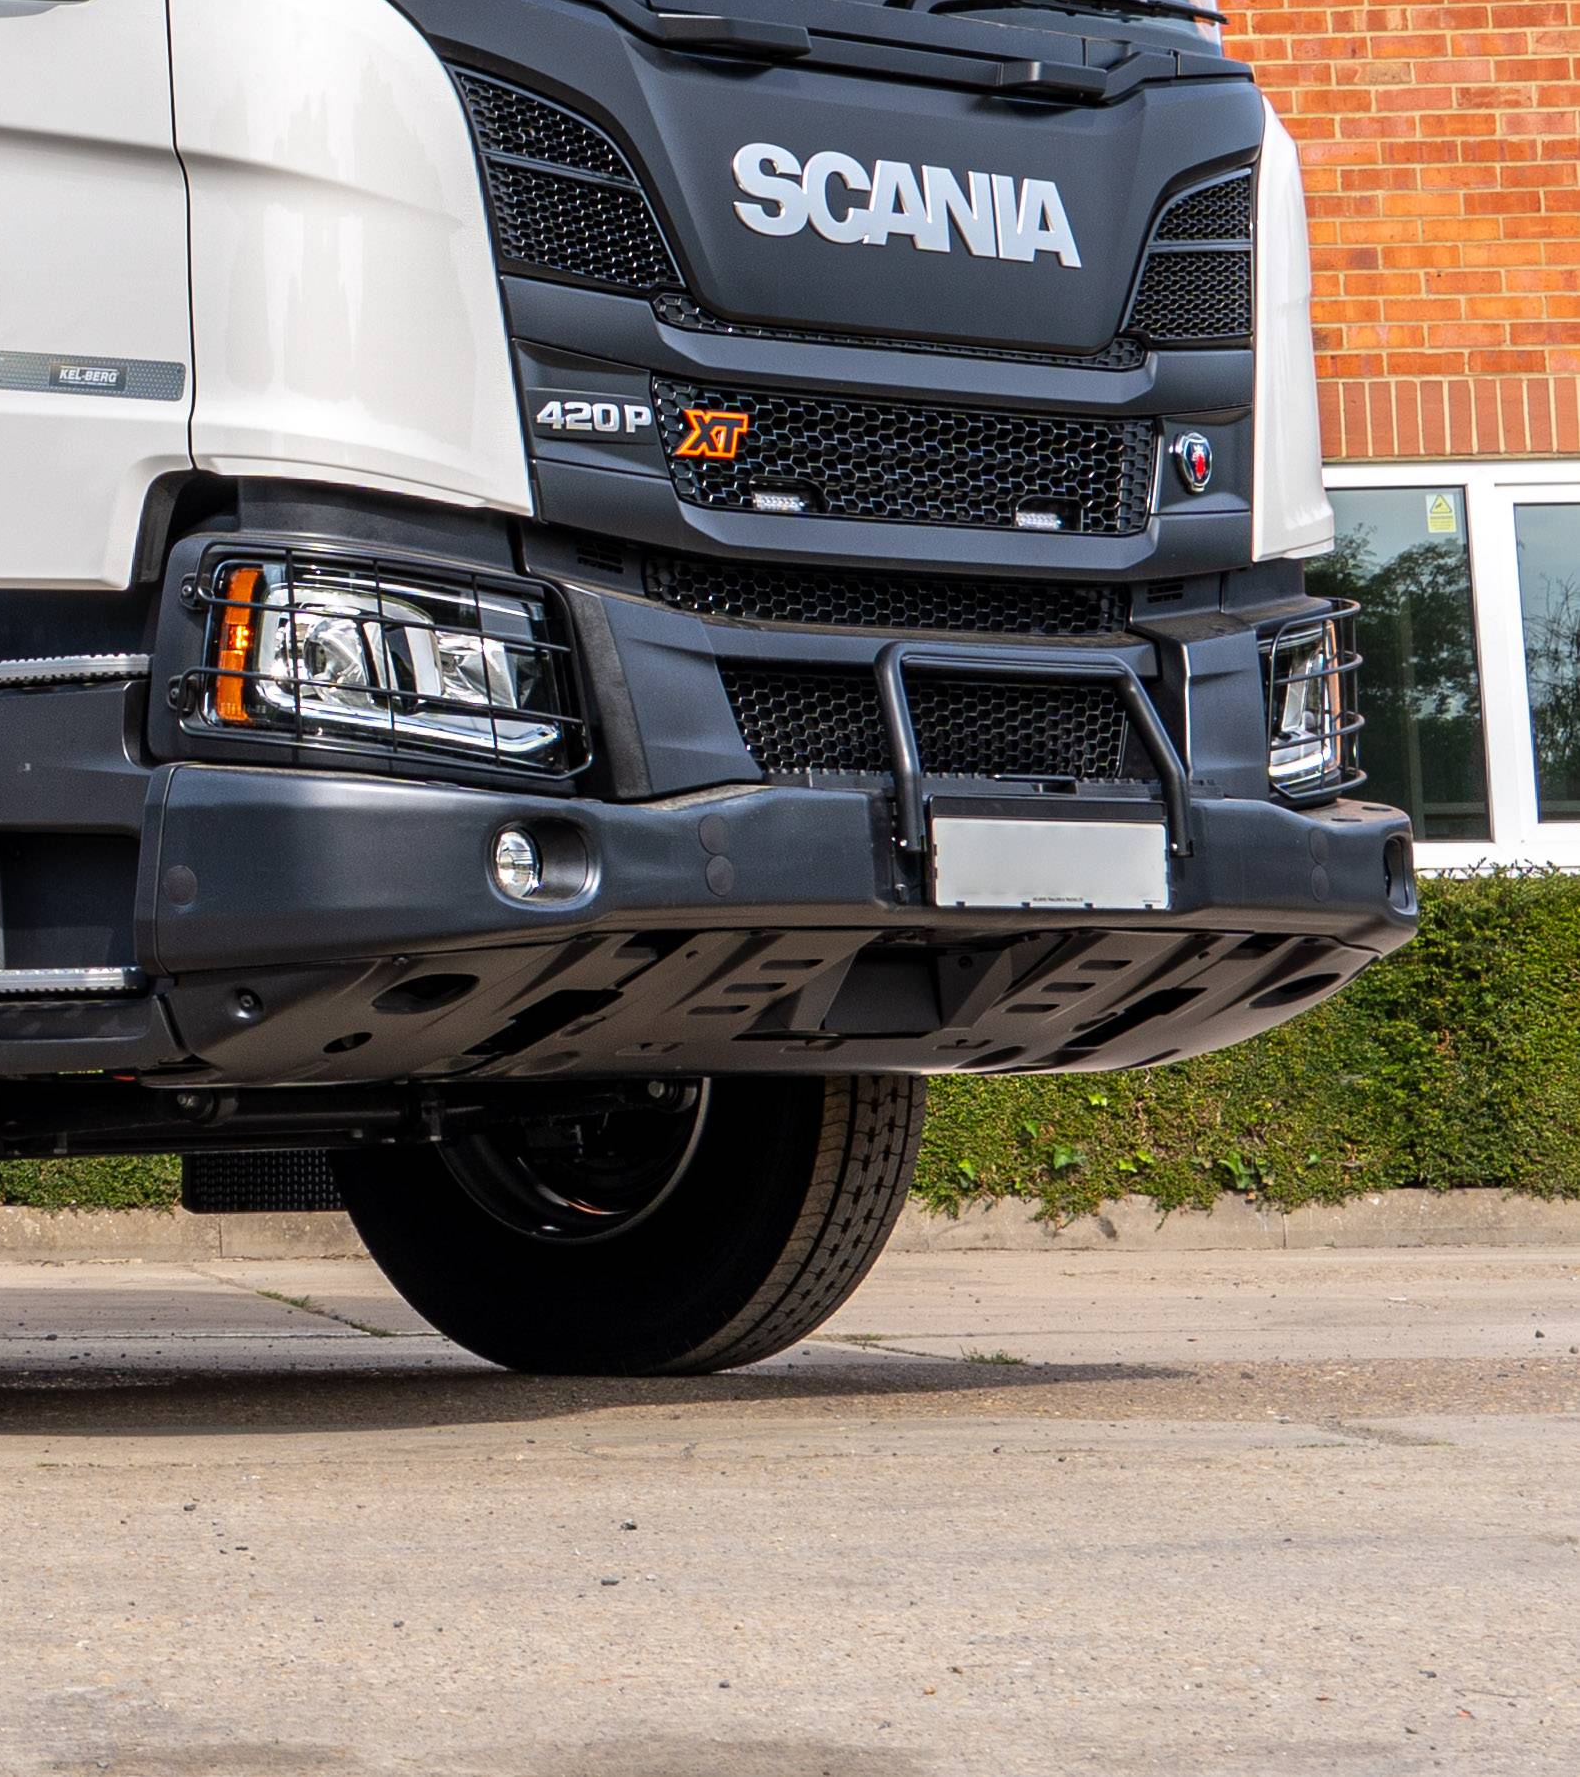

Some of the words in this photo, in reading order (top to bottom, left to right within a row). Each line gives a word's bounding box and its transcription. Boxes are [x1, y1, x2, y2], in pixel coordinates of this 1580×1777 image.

[731, 141, 1082, 269] SCANIA
[59, 367, 118, 383] KEL-BERG
[673, 408, 749, 459] XT
